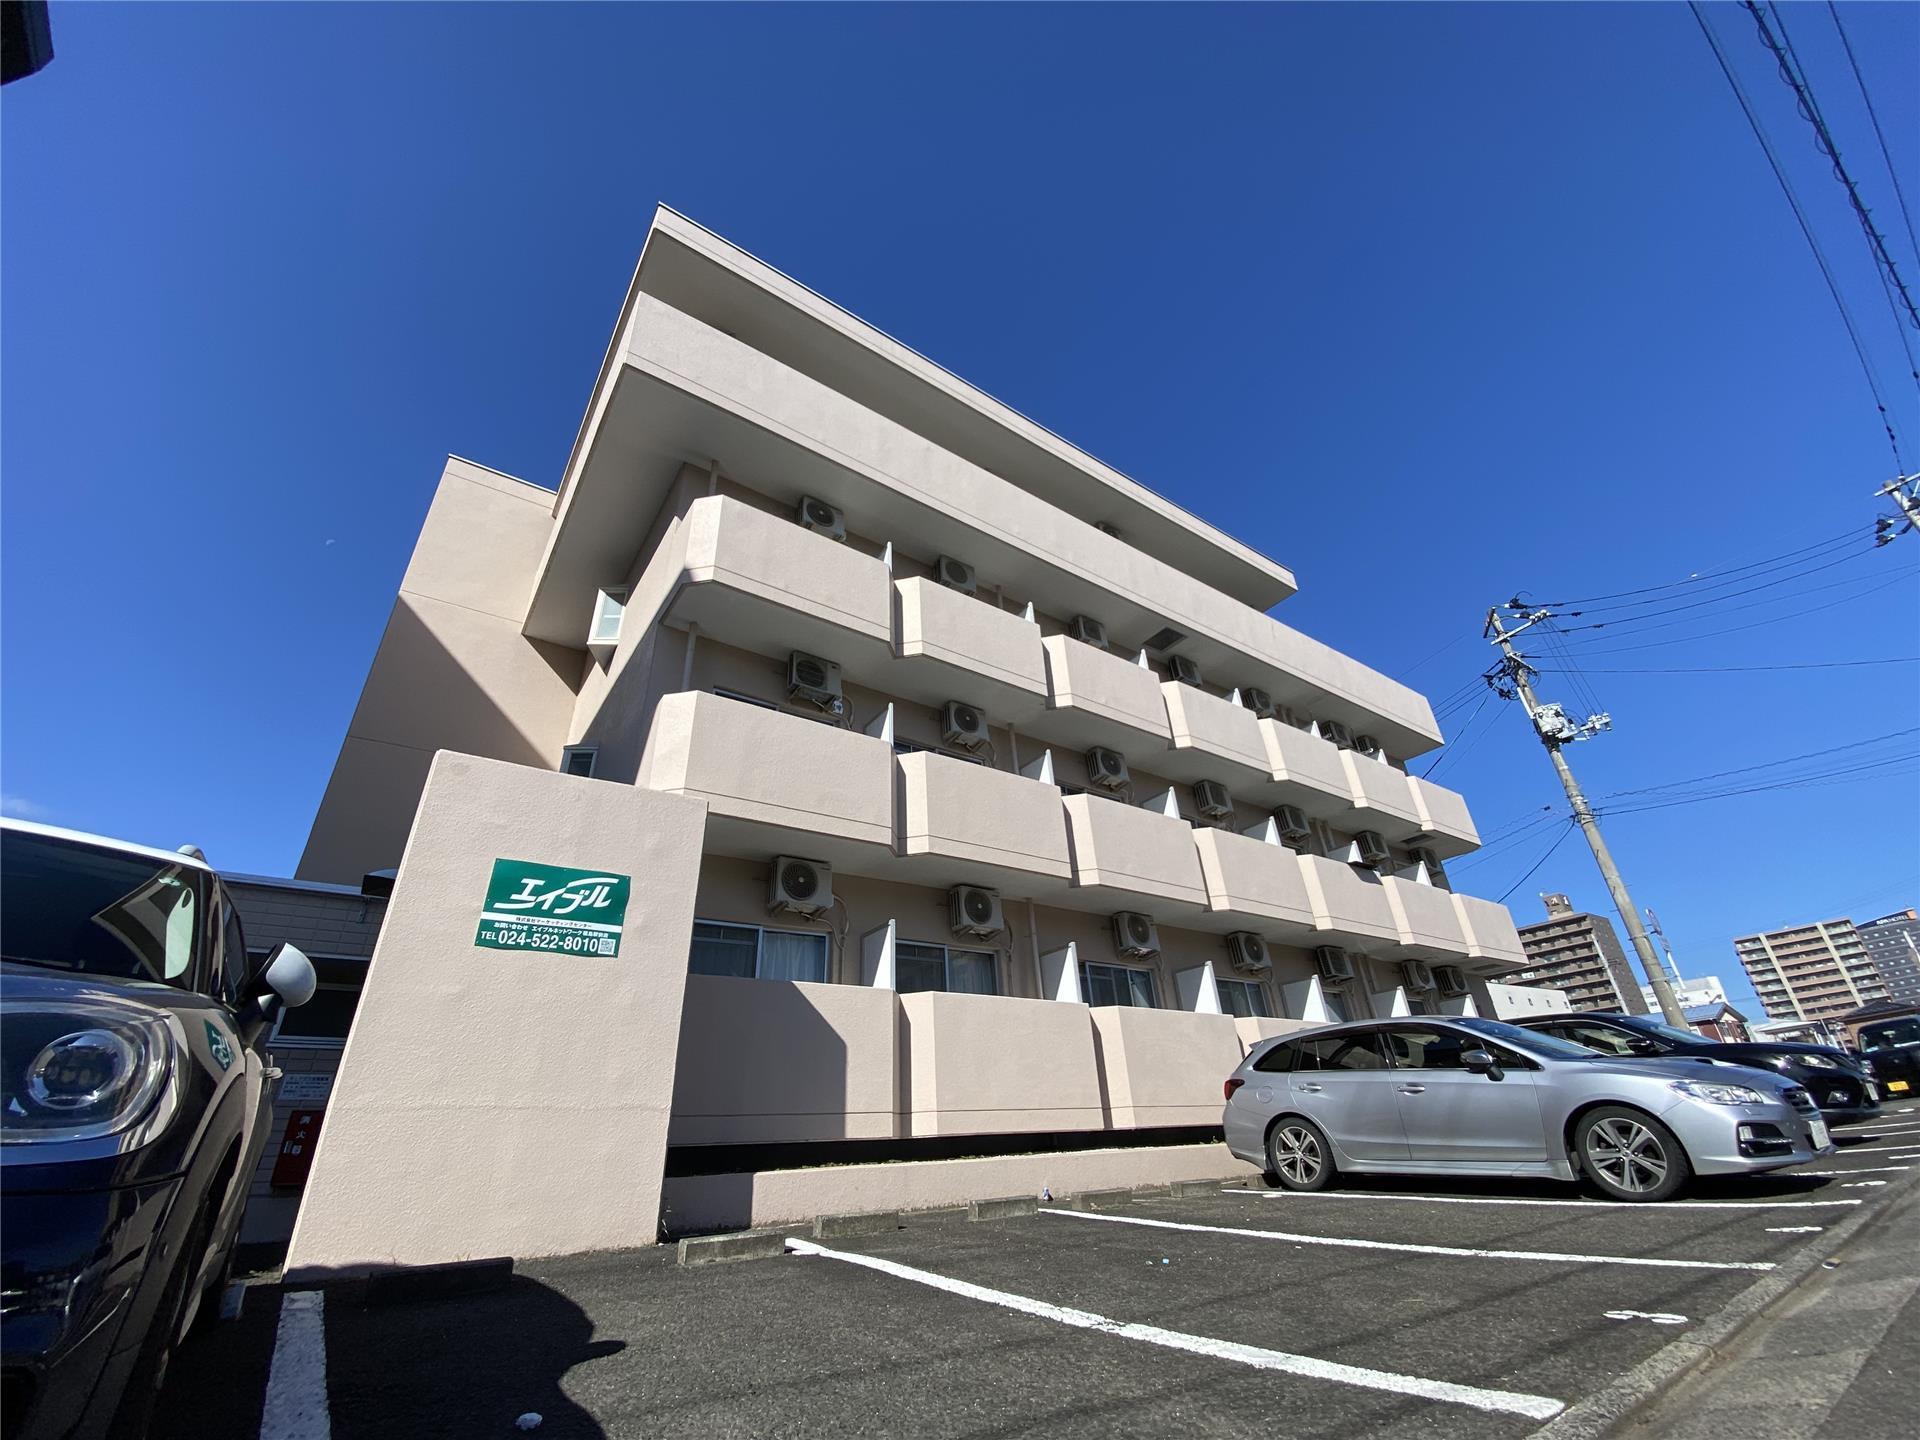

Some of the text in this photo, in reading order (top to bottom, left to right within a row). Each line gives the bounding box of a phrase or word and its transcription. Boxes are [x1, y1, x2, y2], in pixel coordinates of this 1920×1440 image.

[493, 877, 619, 914] エイブル
[481, 931, 598, 952] TEL 024-522-8010
